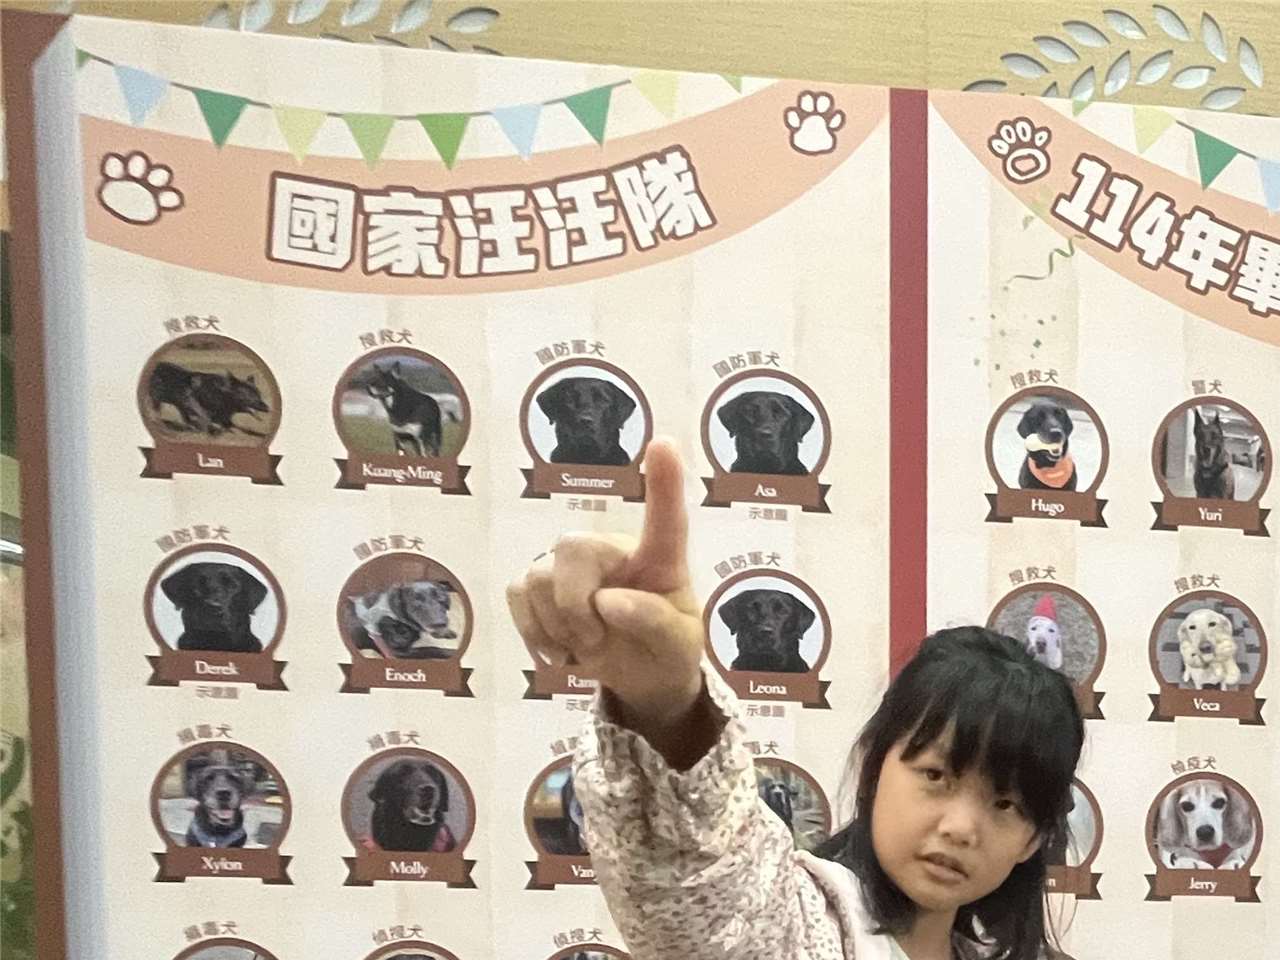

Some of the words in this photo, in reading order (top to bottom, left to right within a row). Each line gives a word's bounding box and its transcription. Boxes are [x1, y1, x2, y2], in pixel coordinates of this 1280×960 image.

[269, 149, 714, 277] 國家汪汪隊
[197, 453, 224, 468] Lan
[561, 473, 615, 489] Summer
[1031, 499, 1064, 517] Hugo
[1199, 507, 1222, 521] Yuri
[195, 661, 240, 676] Derek
[385, 668, 426, 682] Enoch
[750, 680, 787, 695] Leona
[390, 861, 430, 879] Molly
[1189, 877, 1217, 893] Jerry
